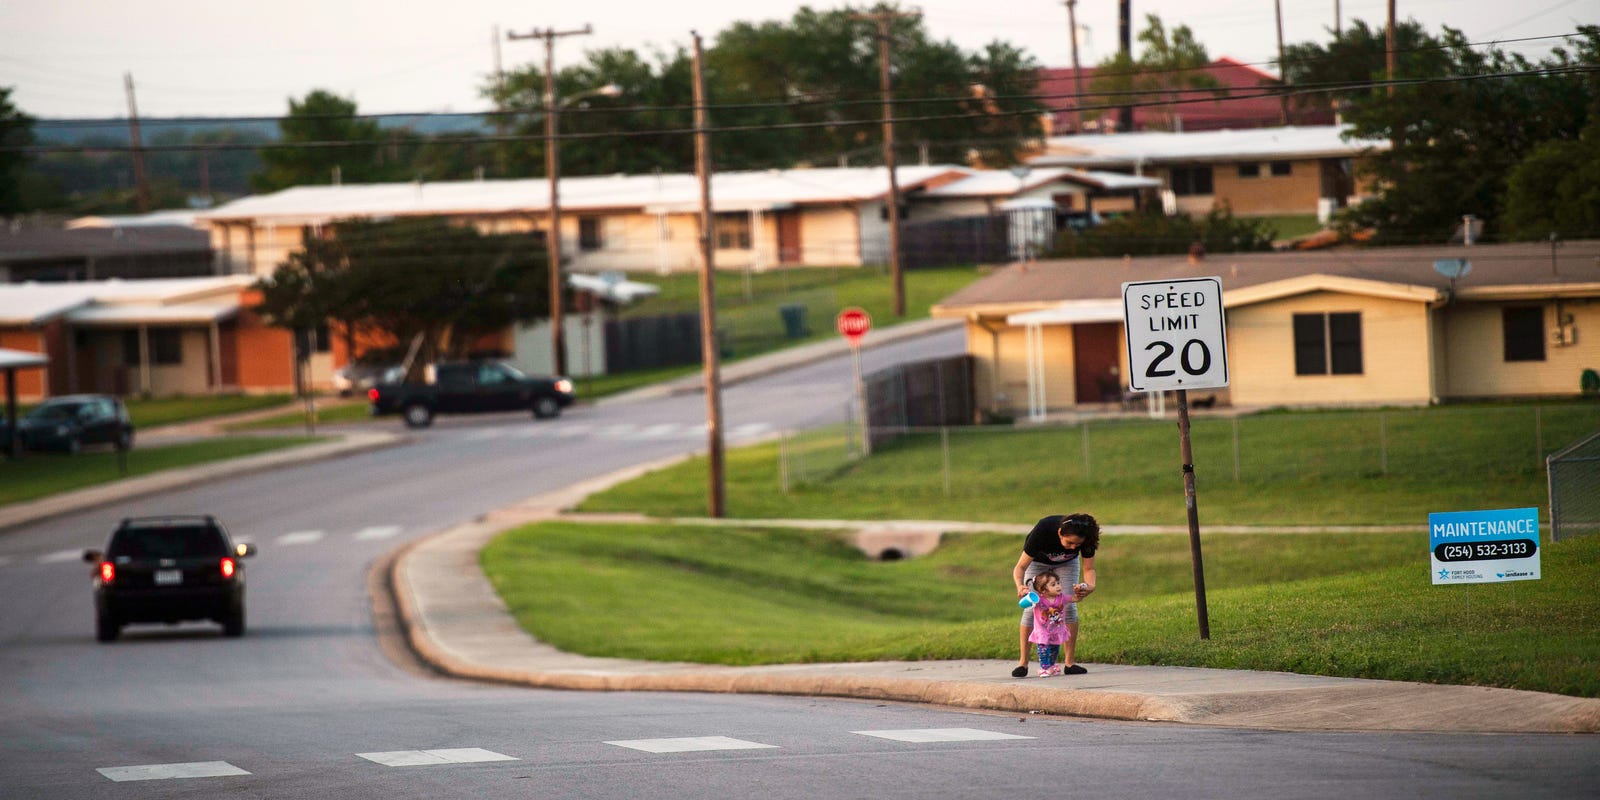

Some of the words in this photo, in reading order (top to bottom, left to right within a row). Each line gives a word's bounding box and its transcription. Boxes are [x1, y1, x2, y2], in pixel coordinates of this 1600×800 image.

[1141, 292, 1205, 310] SPEED
[1149, 314, 1199, 332] LIMIT
[1145, 339, 1211, 378] 20
[1433, 519, 1535, 538] MAINTENANCE
[1444, 545, 1473, 560] (254)
[1477, 543, 1527, 556] 532-3133
